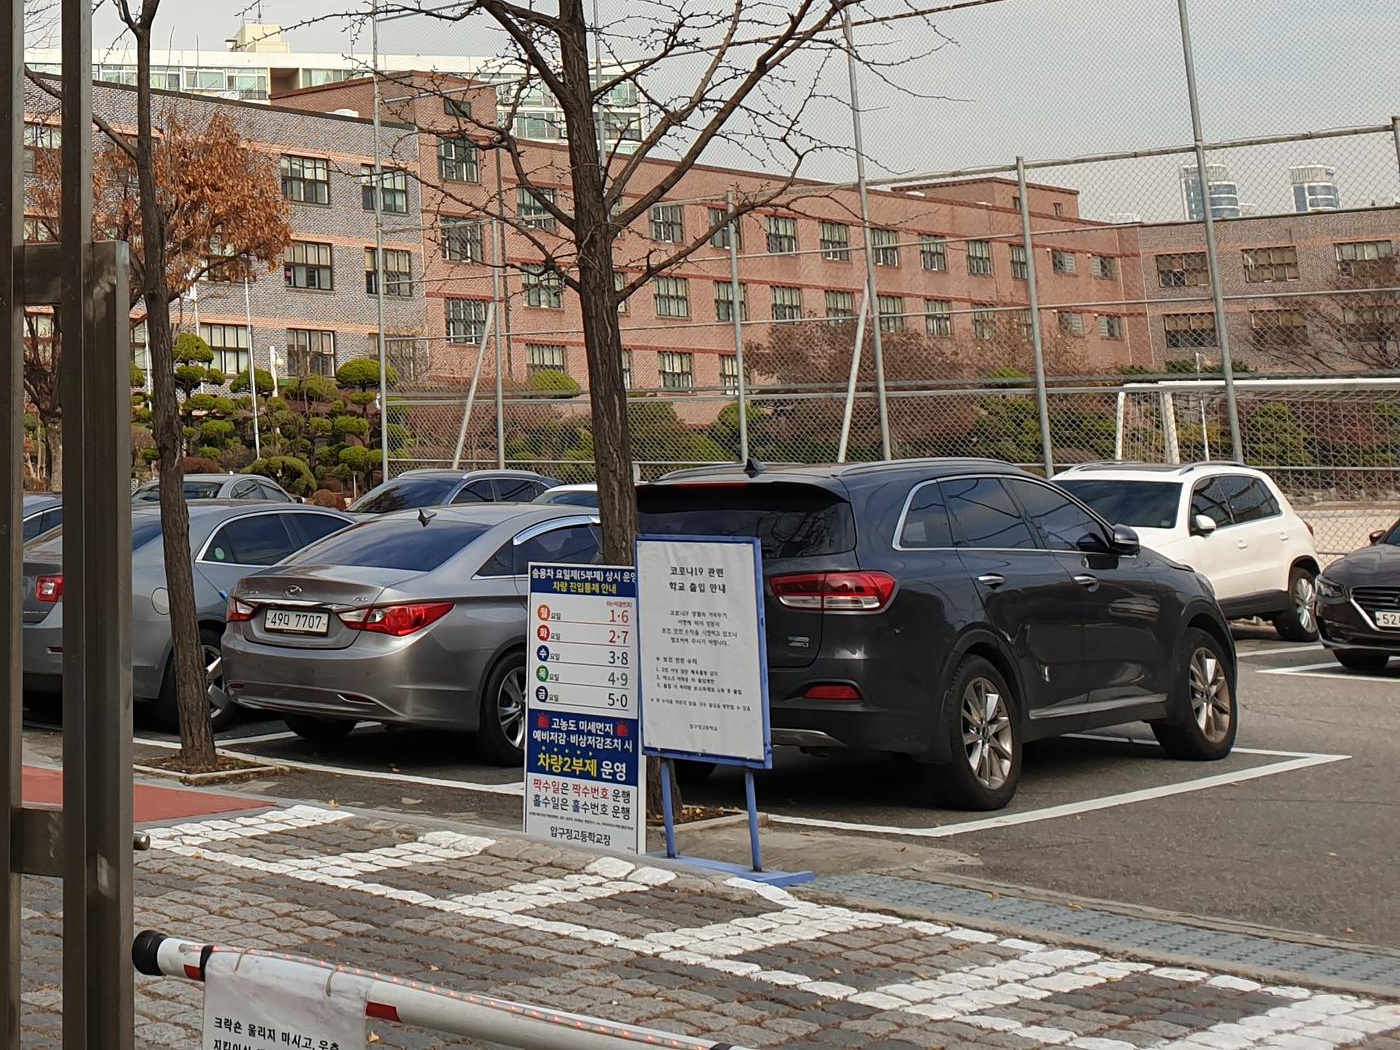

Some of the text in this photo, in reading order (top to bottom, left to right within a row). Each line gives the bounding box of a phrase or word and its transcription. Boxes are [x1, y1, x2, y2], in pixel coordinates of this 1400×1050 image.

[531, 568, 554, 579] 승용차
[556, 569, 604, 581] 요일제(5부제)
[605, 571, 621, 582] 상시
[670, 566, 724, 578] 코로나19 관련
[553, 581, 617, 595] 차량 진입통제 안내
[669, 581, 726, 594] 학교 출입 안내
[295, 614, 322, 629] 7707
[551, 717, 614, 736] 고농도 미세먼지
[623, 740, 633, 753] 시
[537, 752, 627, 782] 차량2부제 운영
[533, 778, 631, 804] 짝수일은 짝수번호 운행
[533, 793, 630, 820] 홀수일은 홀수번호 운행
[550, 825, 611, 846] 압구정고등학교장
[214, 1017, 243, 1035] 크락숀
[248, 1023, 276, 1043] 울리지
